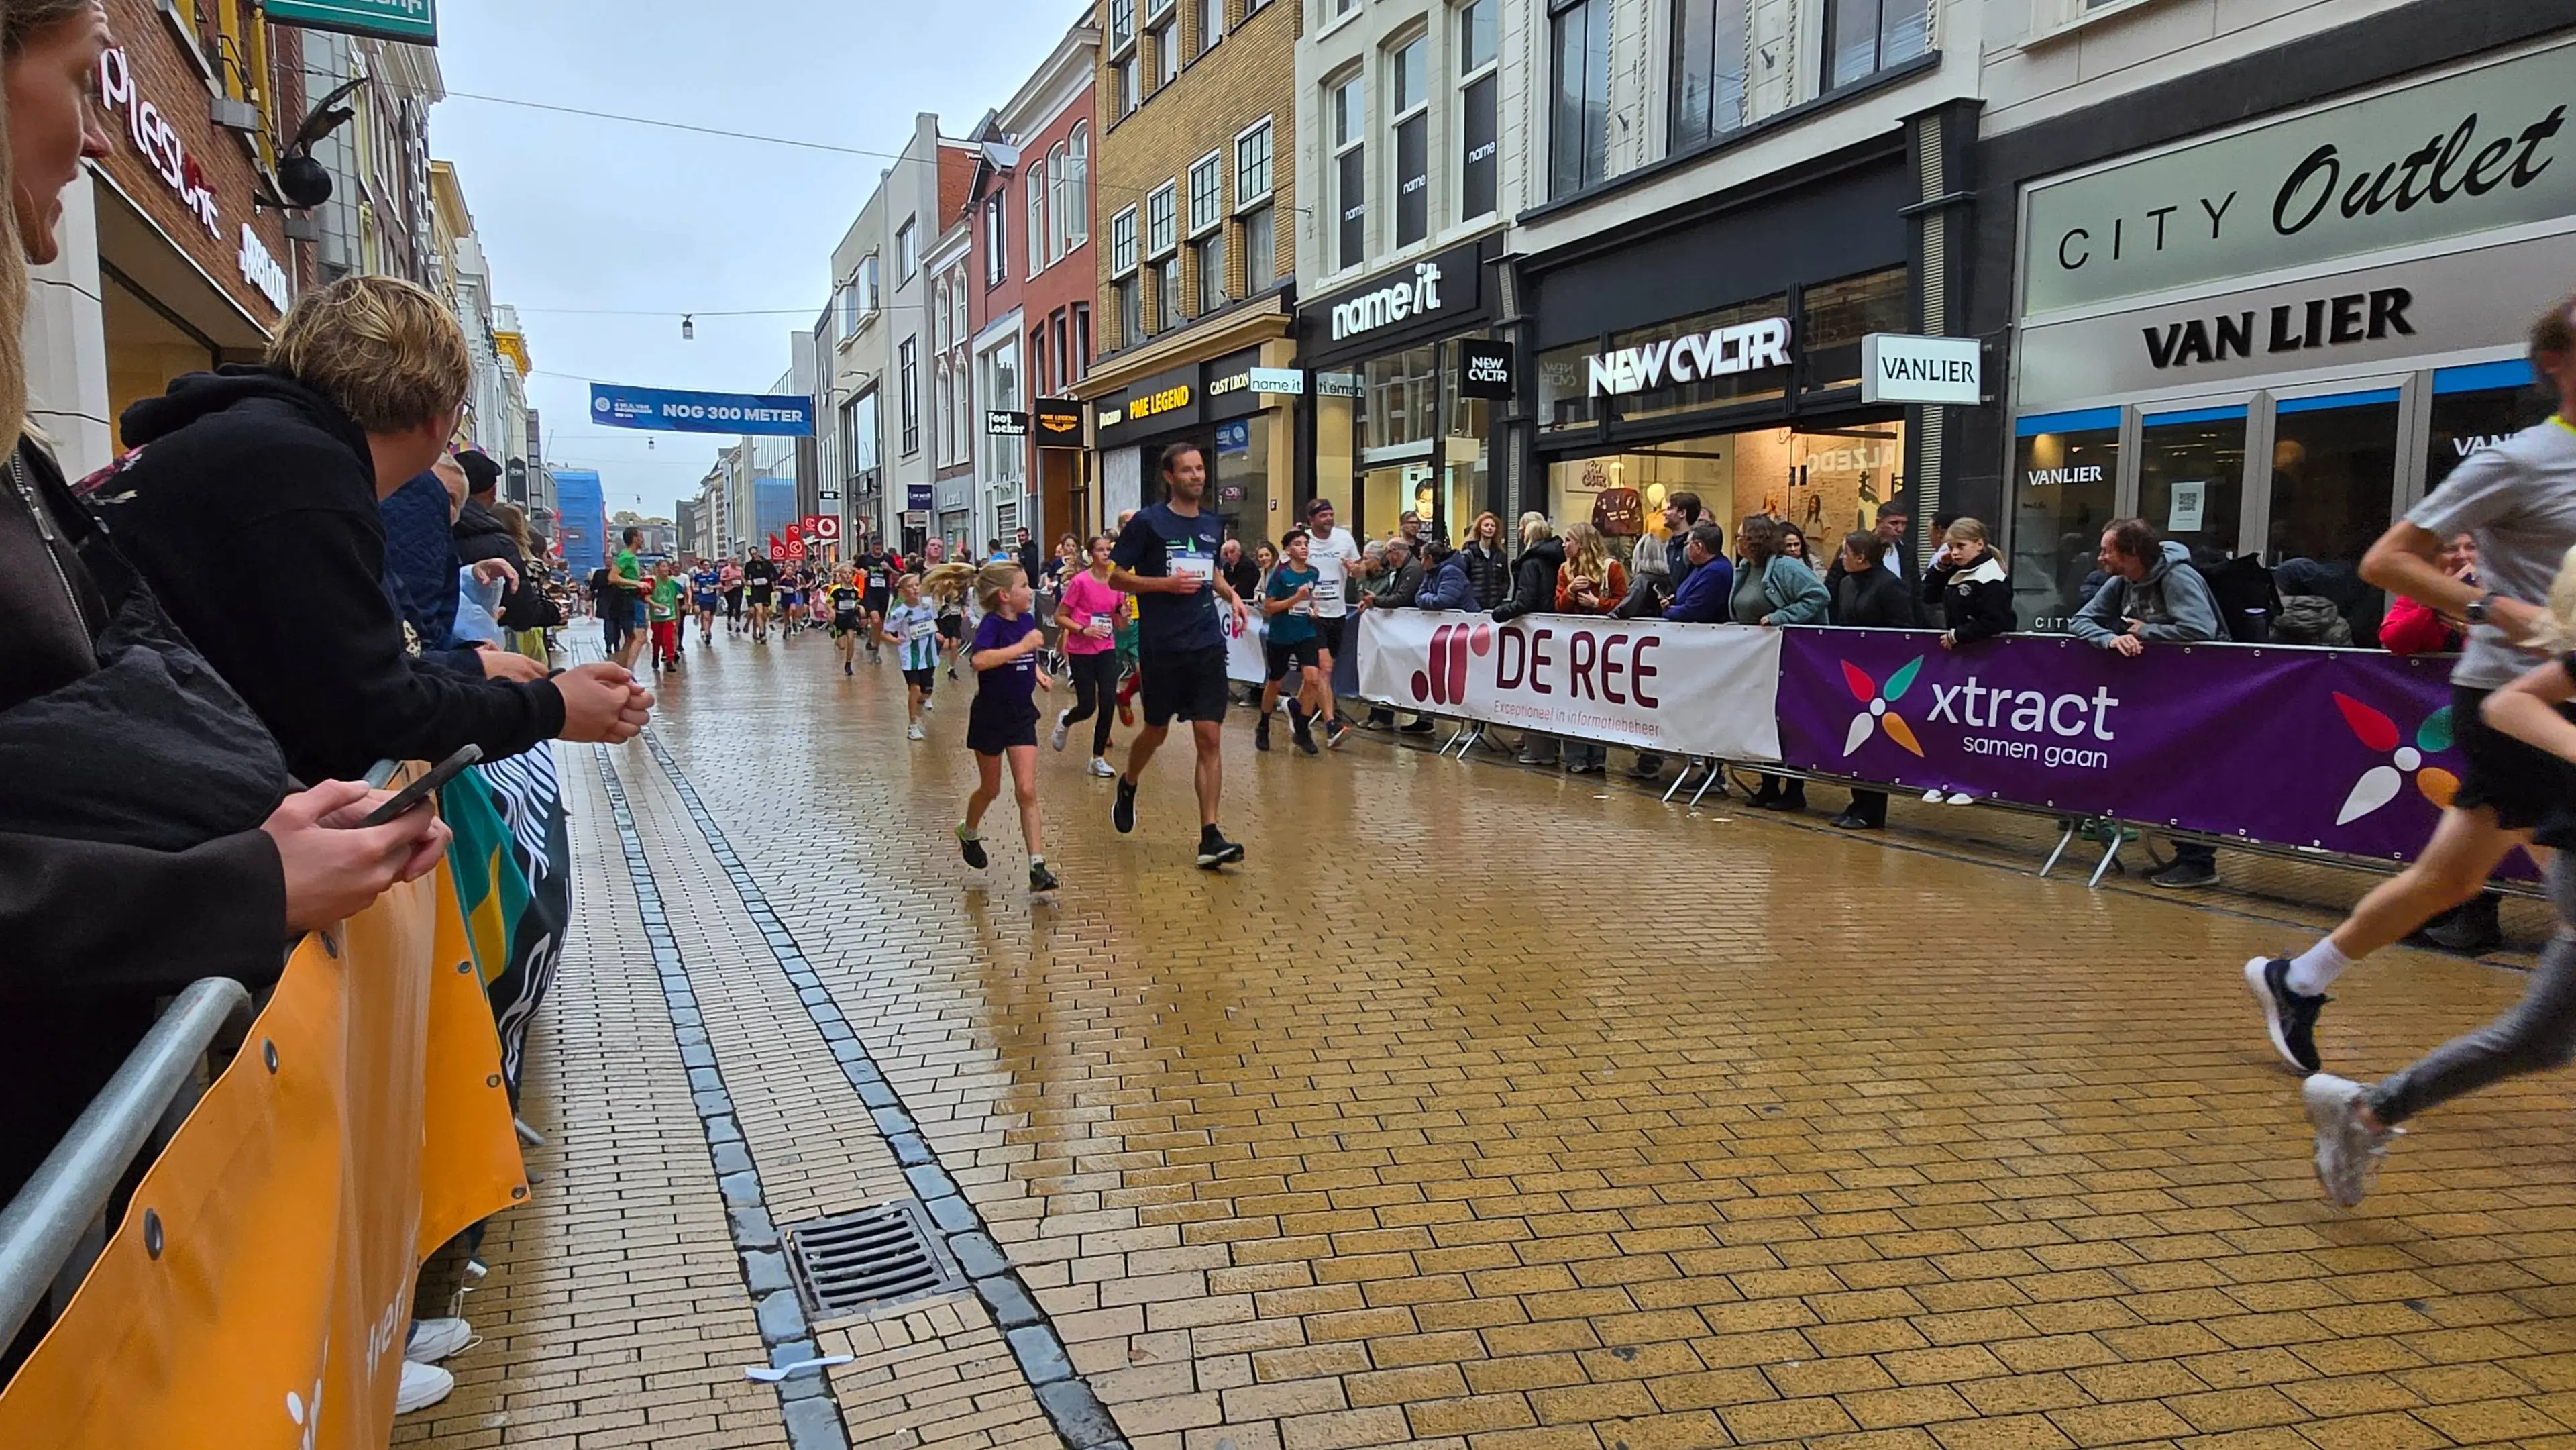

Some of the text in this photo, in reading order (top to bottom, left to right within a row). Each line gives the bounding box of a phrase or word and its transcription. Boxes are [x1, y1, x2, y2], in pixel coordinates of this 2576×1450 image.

[1468, 140, 1495, 164] name
[1403, 174, 1426, 195] name
[2058, 104, 2568, 270] CITY Outlet
[1332, 262, 1441, 341] name it
[2142, 287, 2417, 369] VAN LIER
[1472, 356, 1504, 369] NEW
[1588, 317, 1794, 397] NEW CVLTR
[1882, 356, 1975, 384] VANLIER
[1210, 377, 1229, 395] CAST
[1252, 378, 1301, 391] name it
[1468, 368, 1507, 382] CVLTR
[662, 403, 803, 423] NOG 300 METER
[1130, 397, 1150, 421] PME
[1150, 384, 1189, 414] LEGEND
[987, 412, 1012, 423] Foot
[988, 422, 1025, 434] Locker
[2028, 466, 2103, 486] VANLIER
[1496, 626, 1660, 709] DE REE
[1494, 701, 1659, 737] Exceptioneel in informatiebeheer
[1927, 676, 2119, 741] xtract
[1963, 737, 2108, 768] samen gaan
